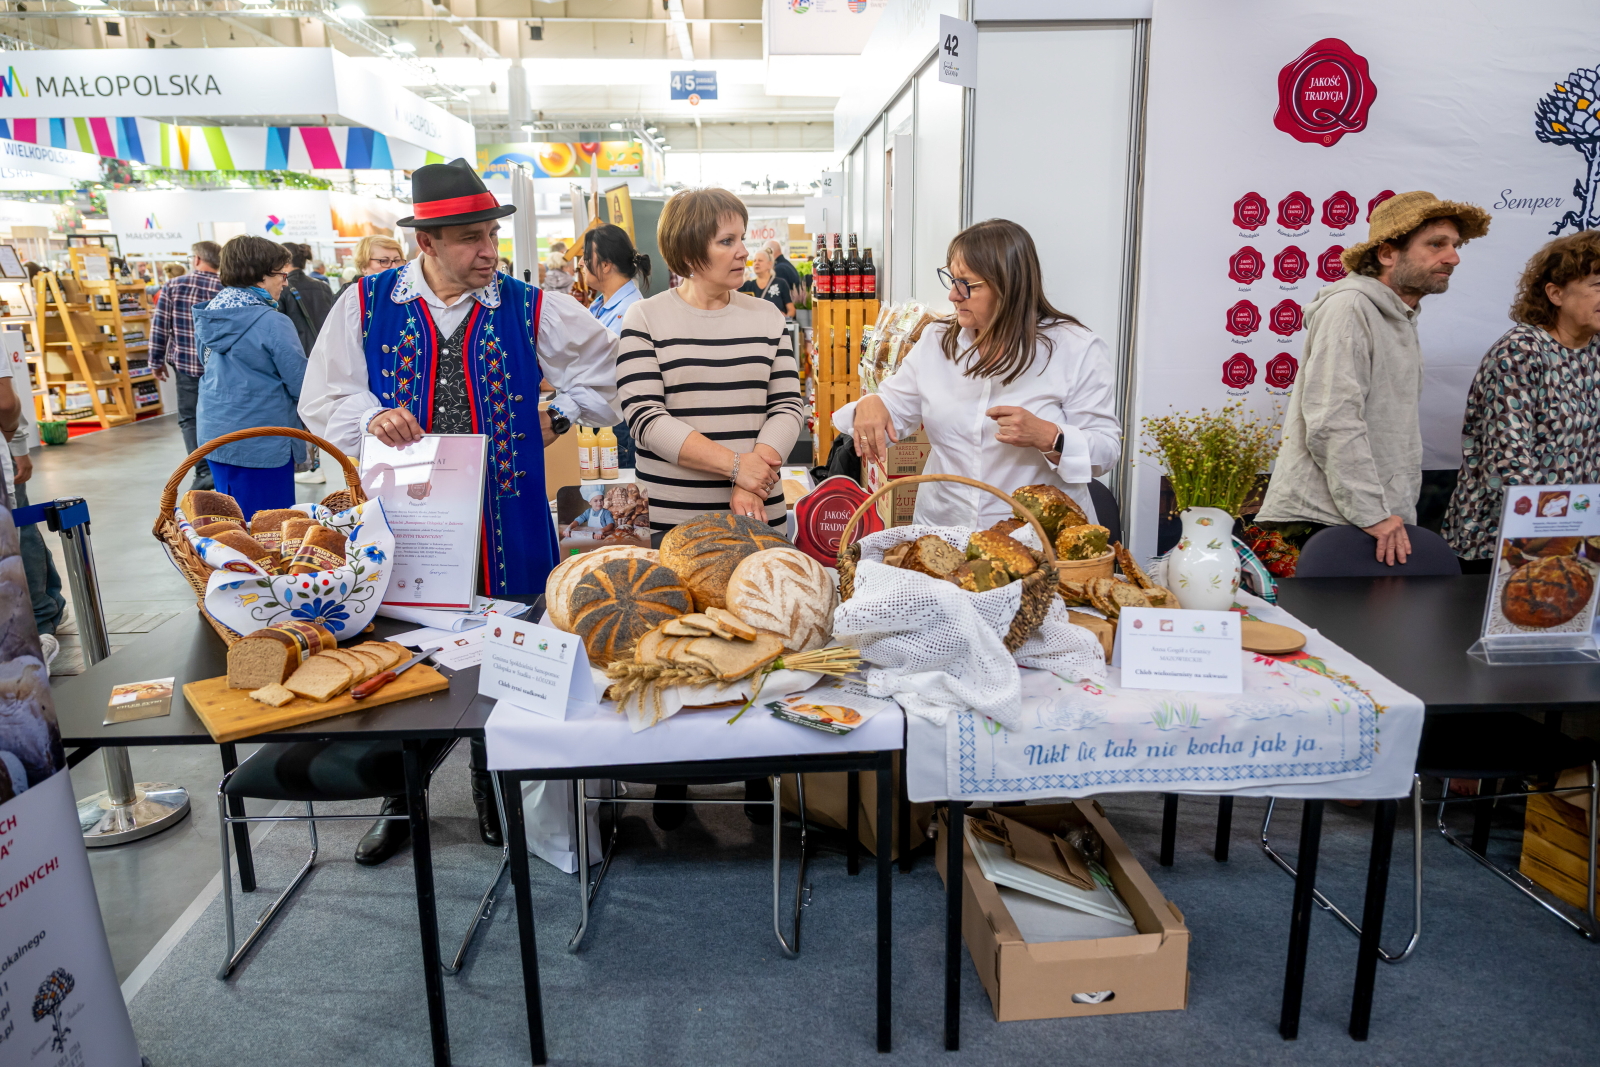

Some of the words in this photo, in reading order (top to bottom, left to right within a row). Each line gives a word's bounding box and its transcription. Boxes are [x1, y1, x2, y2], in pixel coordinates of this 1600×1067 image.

[944, 34, 958, 57] 42
[36, 74, 222, 98] MAŁOPOLSKA
[671, 75, 682, 90] 4
[685, 75, 696, 90] 5
[1308, 75, 1340, 88] JAKOŚĆ
[1304, 91, 1344, 102] TRADYCJA
[4, 142, 76, 164] WIELKOPOLSKA
[824, 178, 832, 186] 42
[1493, 188, 1566, 216] Semper
[126, 232, 182, 240] MAŁOPOLSKA
[750, 226, 775, 240] MIÓD
[823, 510, 852, 520] JAKOŚĆ
[498, 680, 510, 688] Chleb
[1023, 743, 1070, 766] Nikt
[1104, 739, 1136, 758] tak
[1146, 742, 1178, 758] nie
[1187, 734, 1244, 756] kocha
[1249, 732, 1288, 758] jak
[1292, 734, 1324, 758] ja.
[0, 856, 59, 908] CYJNYCH!
